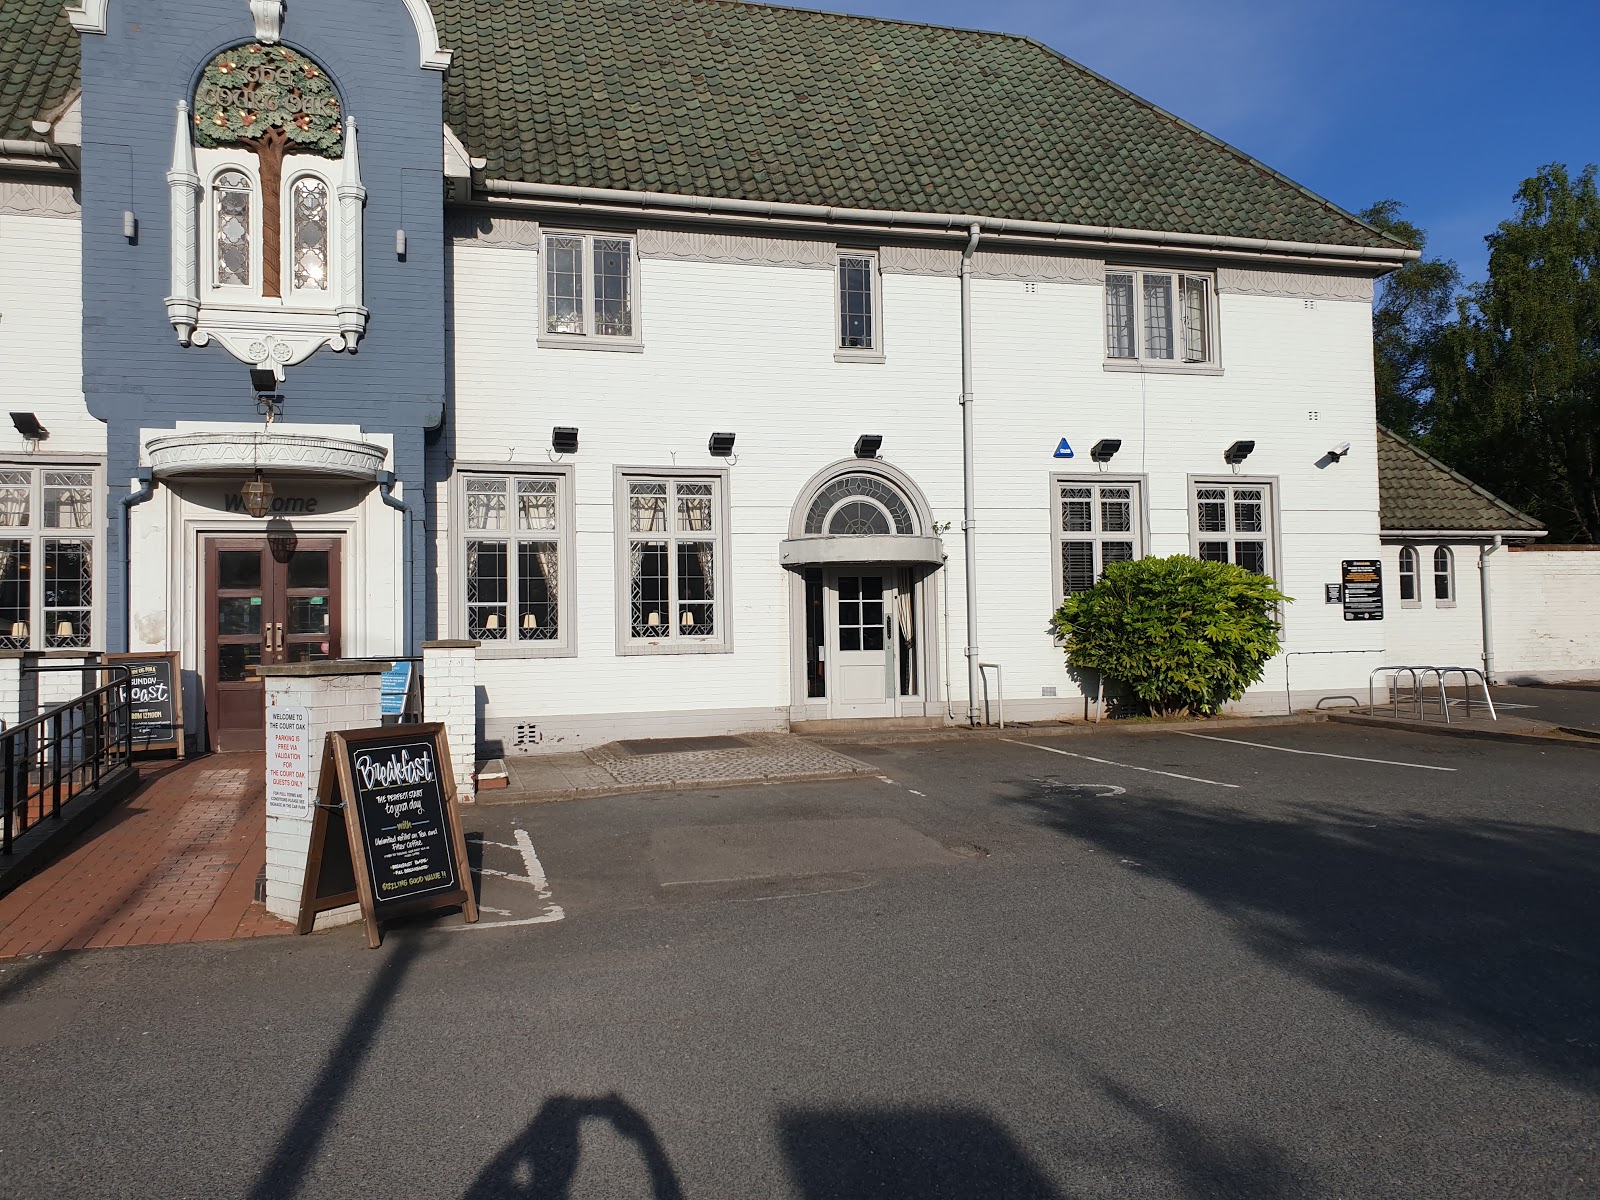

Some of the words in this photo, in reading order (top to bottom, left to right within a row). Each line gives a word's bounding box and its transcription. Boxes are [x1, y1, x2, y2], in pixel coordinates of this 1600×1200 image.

[202, 88, 279, 110] COURT
[284, 94, 332, 117] OAK
[224, 493, 318, 512] Wome
[356, 749, 433, 790] Breakfast
[376, 796, 386, 804] THE
[387, 790, 408, 802] PERFECT
[409, 789, 423, 798] START
[409, 799, 425, 814] day
[396, 820, 412, 830] with
[375, 835, 396, 846] Unlimited
[428, 828, 438, 836] and
[382, 880, 408, 891] SIZZLING
[409, 875, 424, 885] GOOD
[424, 872, 441, 882] VALUE
